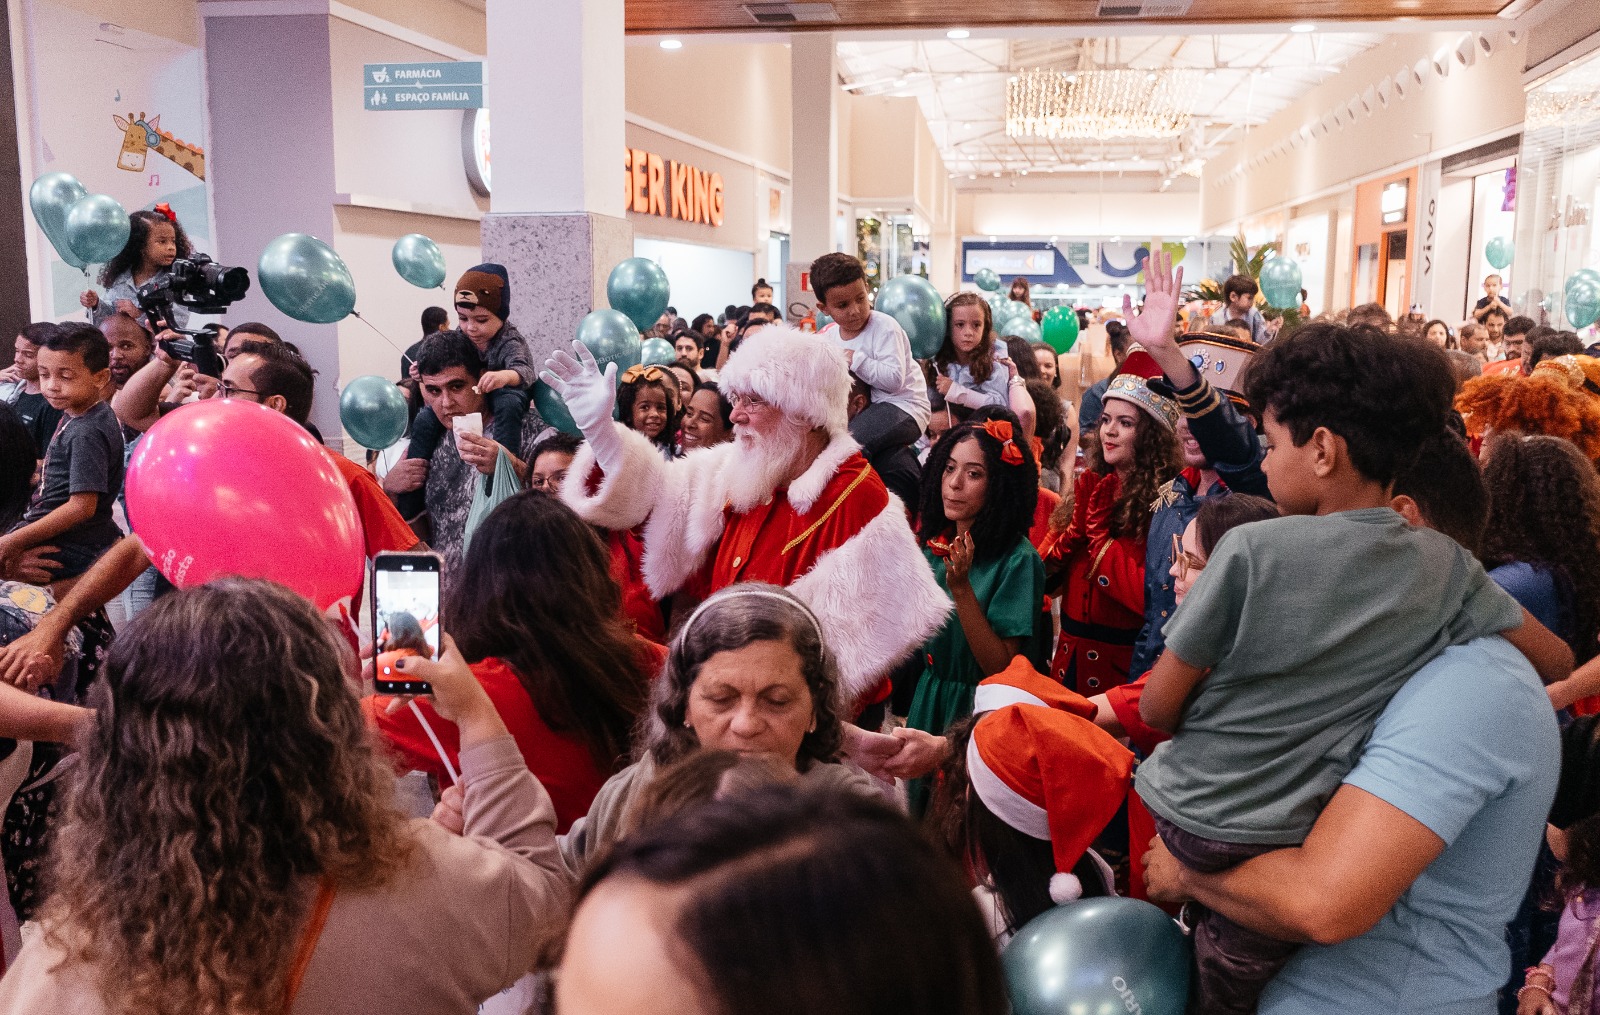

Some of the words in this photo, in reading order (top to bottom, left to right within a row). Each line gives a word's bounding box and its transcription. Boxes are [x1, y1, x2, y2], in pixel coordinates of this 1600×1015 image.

[395, 69, 442, 79] FARMÁCIA
[395, 93, 429, 104] ESPAÇO
[432, 90, 469, 101] FAMÍLIA
[670, 160, 724, 227] KING
